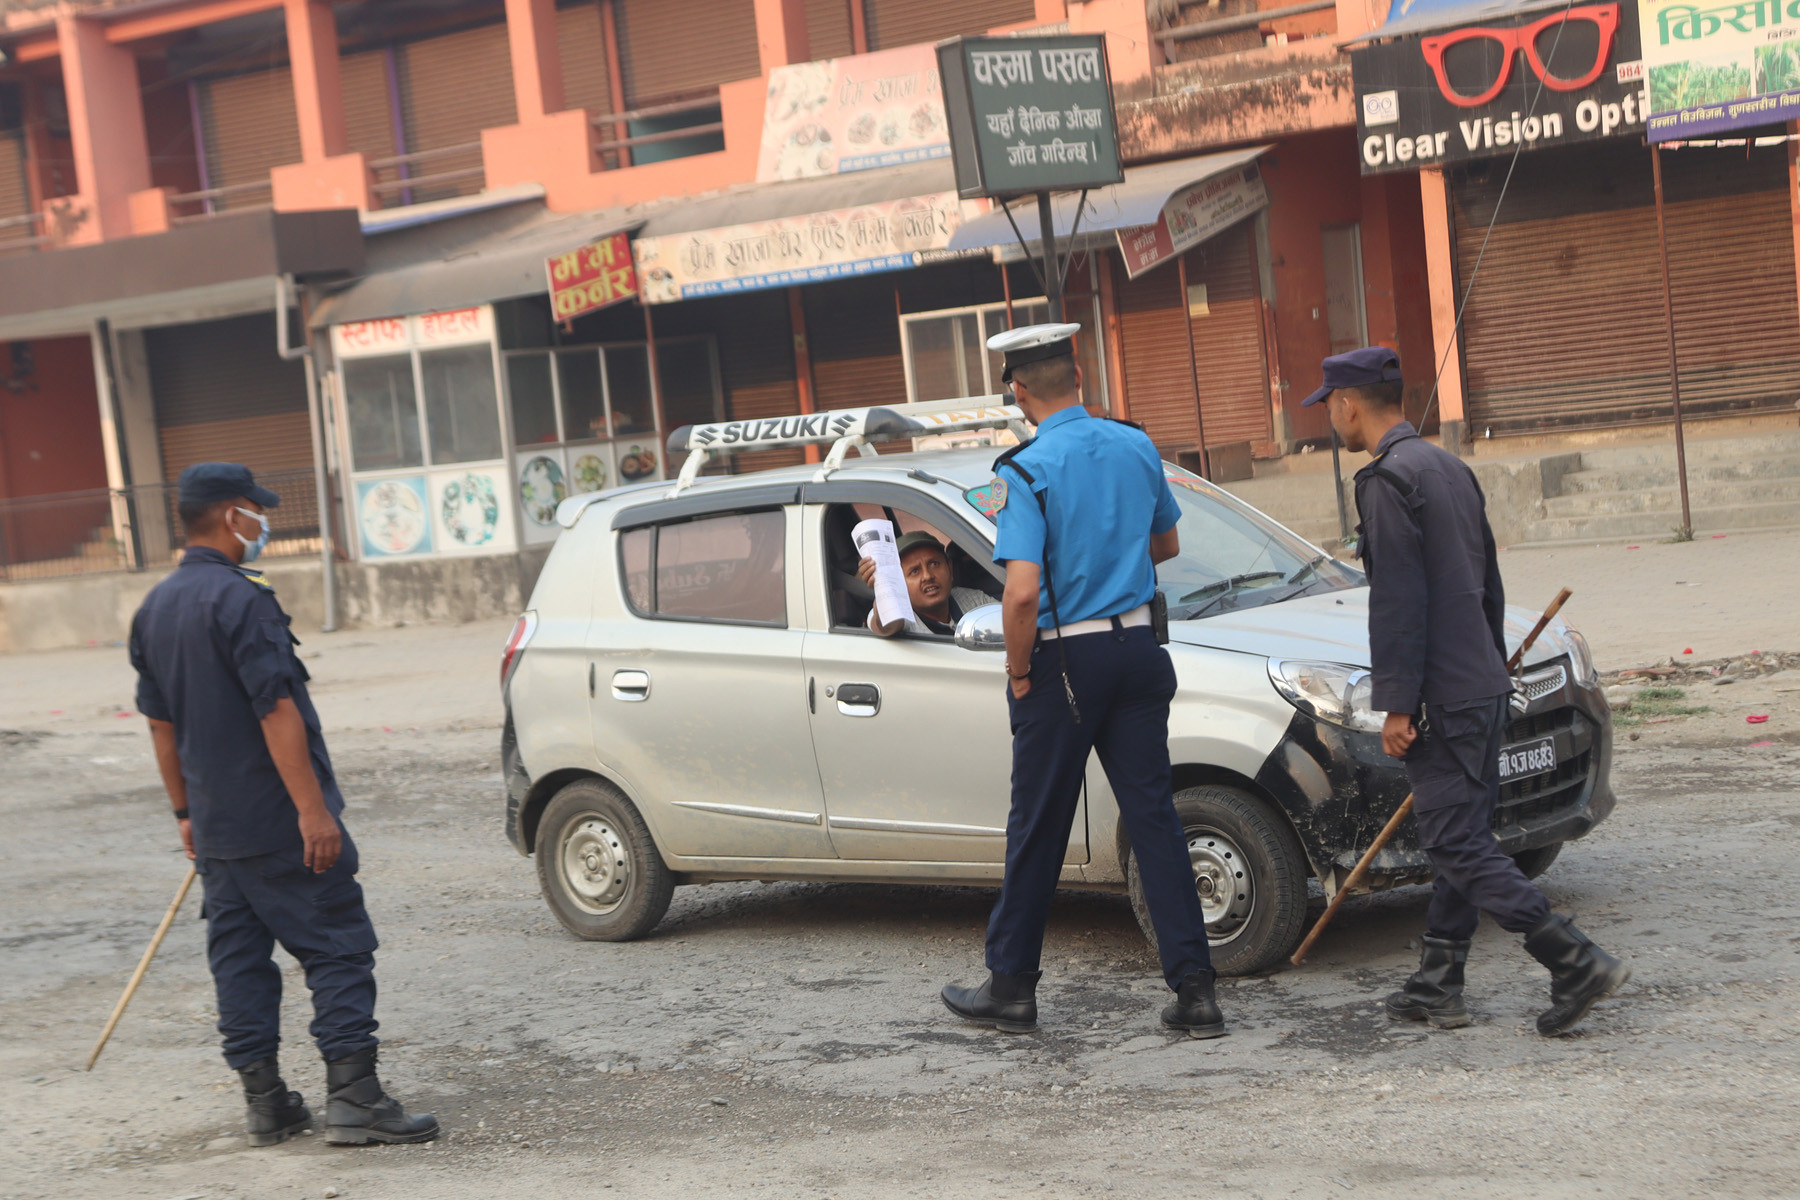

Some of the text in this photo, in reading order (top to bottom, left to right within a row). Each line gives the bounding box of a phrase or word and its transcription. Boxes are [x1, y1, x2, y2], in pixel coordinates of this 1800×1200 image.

[970, 47, 1101, 87] चस्मा पसल
[1618, 63, 1644, 79] 984
[1018, 105, 1061, 135] दैनिक
[1362, 129, 1449, 167] Clear
[1458, 109, 1563, 152] Vision
[721, 414, 830, 444] SUZUKI
